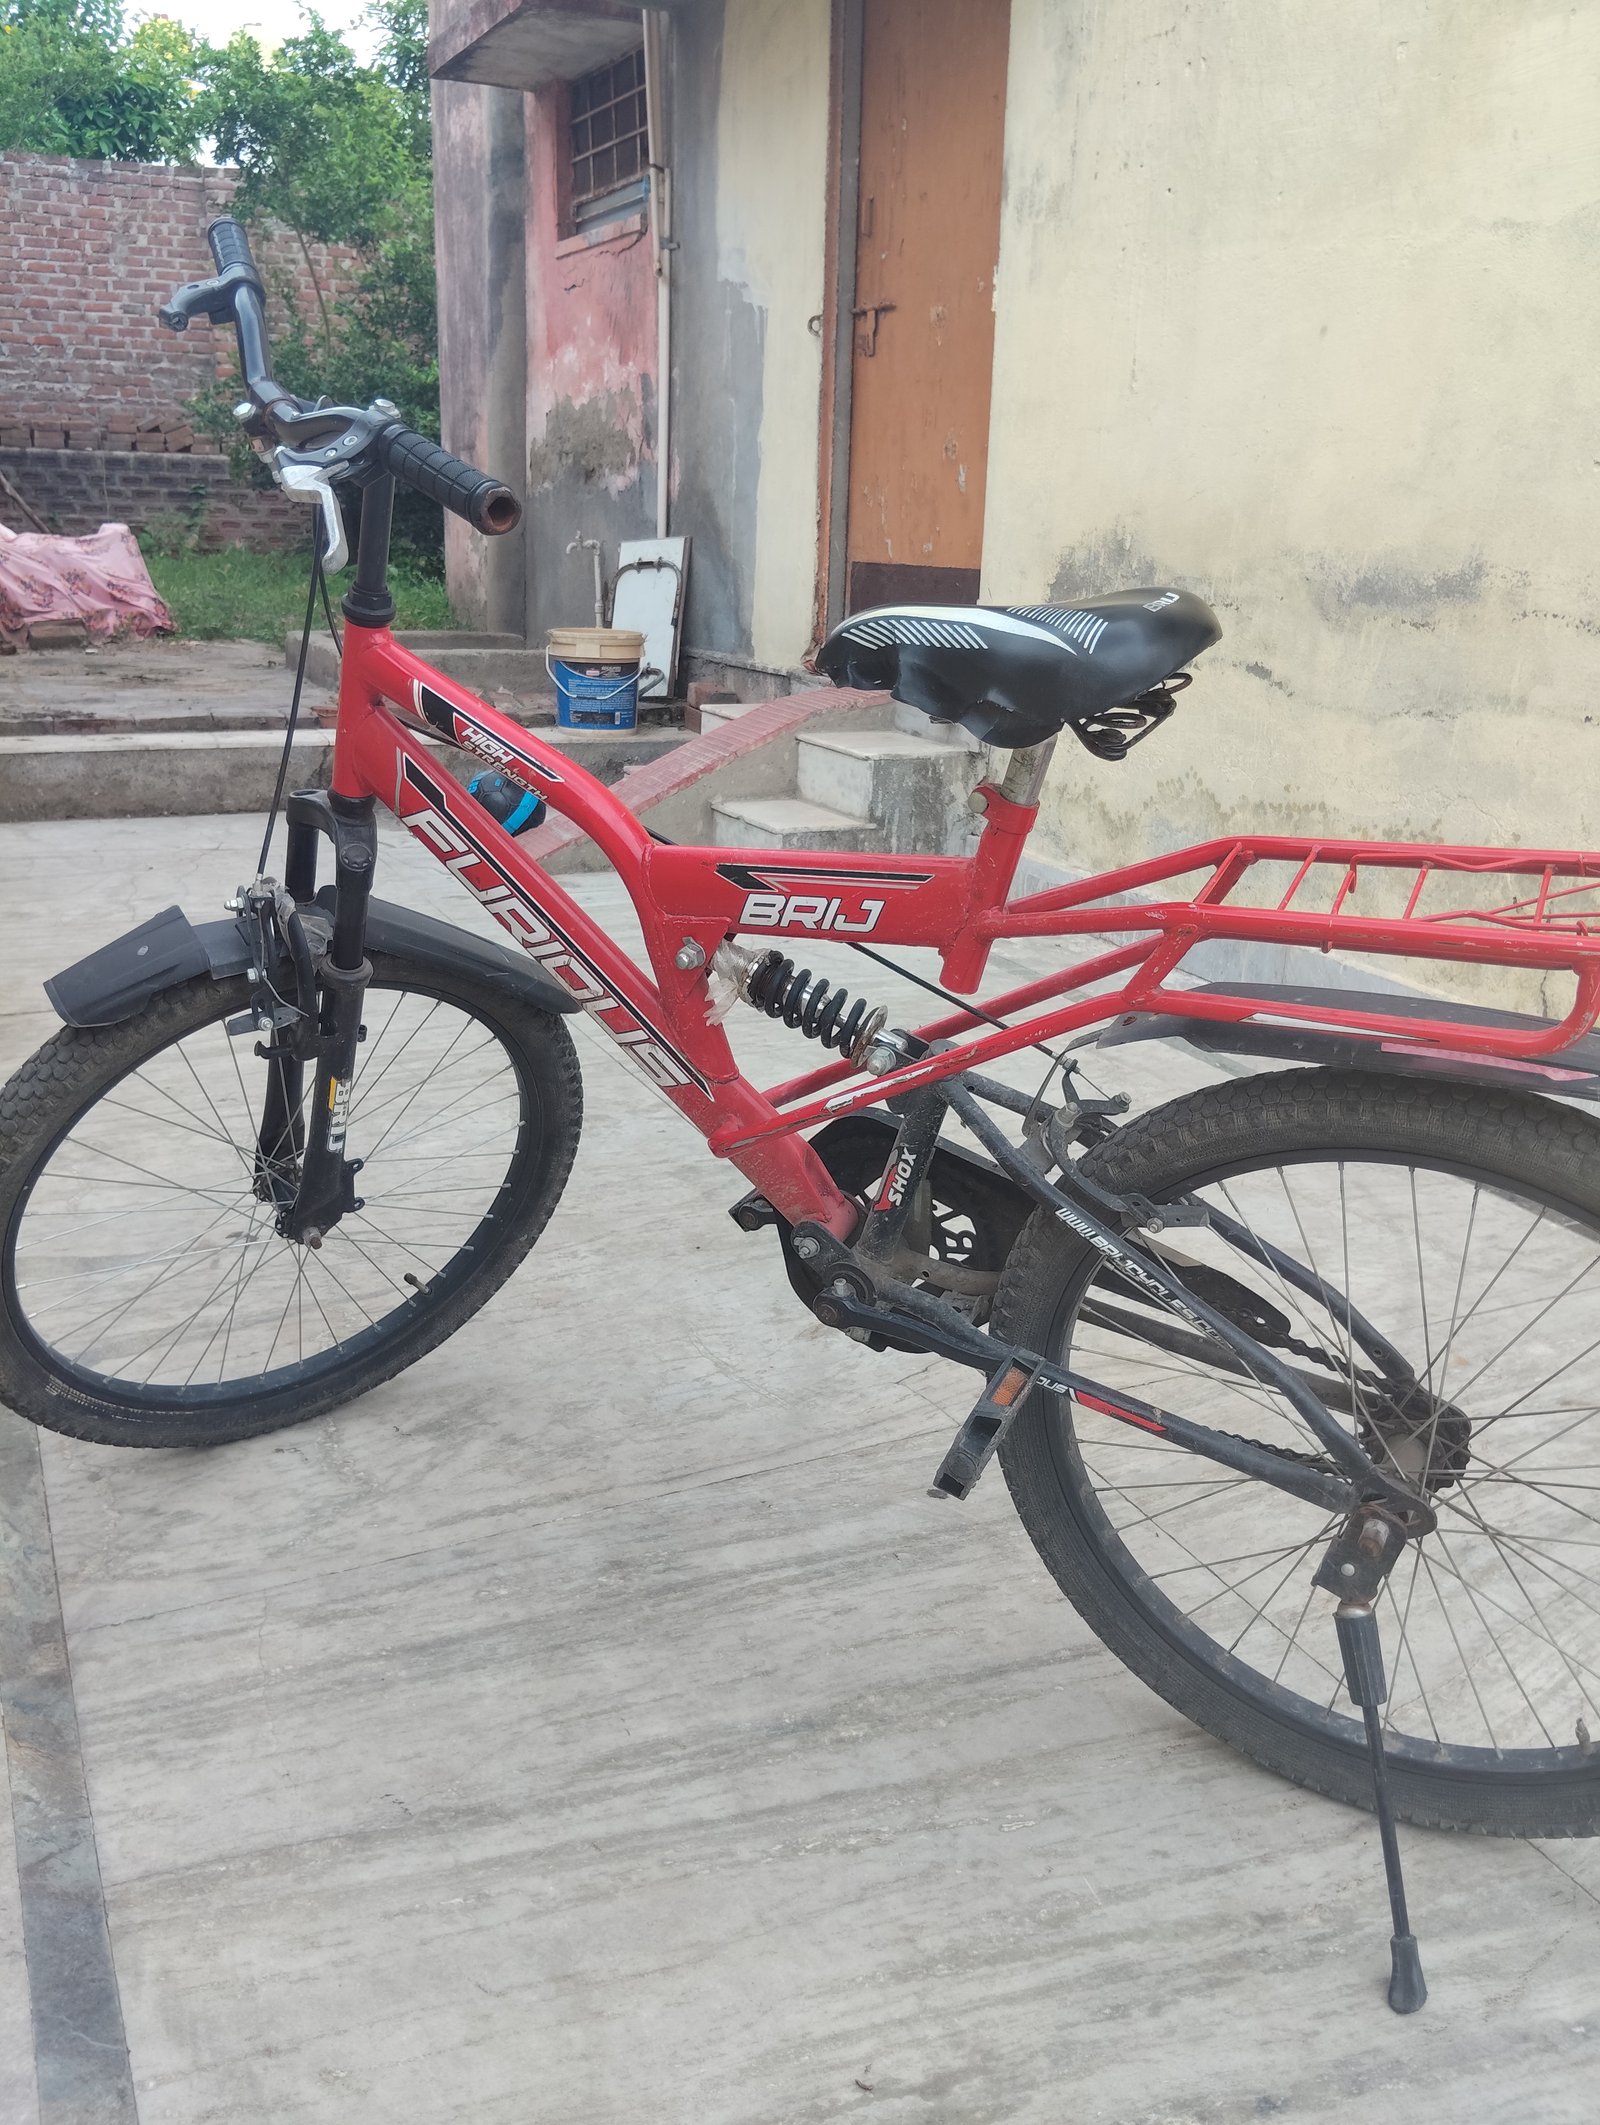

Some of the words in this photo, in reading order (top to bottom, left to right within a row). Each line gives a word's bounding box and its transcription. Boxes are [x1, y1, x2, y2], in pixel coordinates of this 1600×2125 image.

[1142, 592, 1180, 613] BRIJ
[461, 727, 515, 765] HIGH
[462, 740, 548, 801] STRENGTH
[739, 893, 886, 933] BRIJ
[401, 808, 692, 1088] FURIOUS
[328, 1080, 352, 1152] BRIJ
[887, 1146, 917, 1206] SHOX
